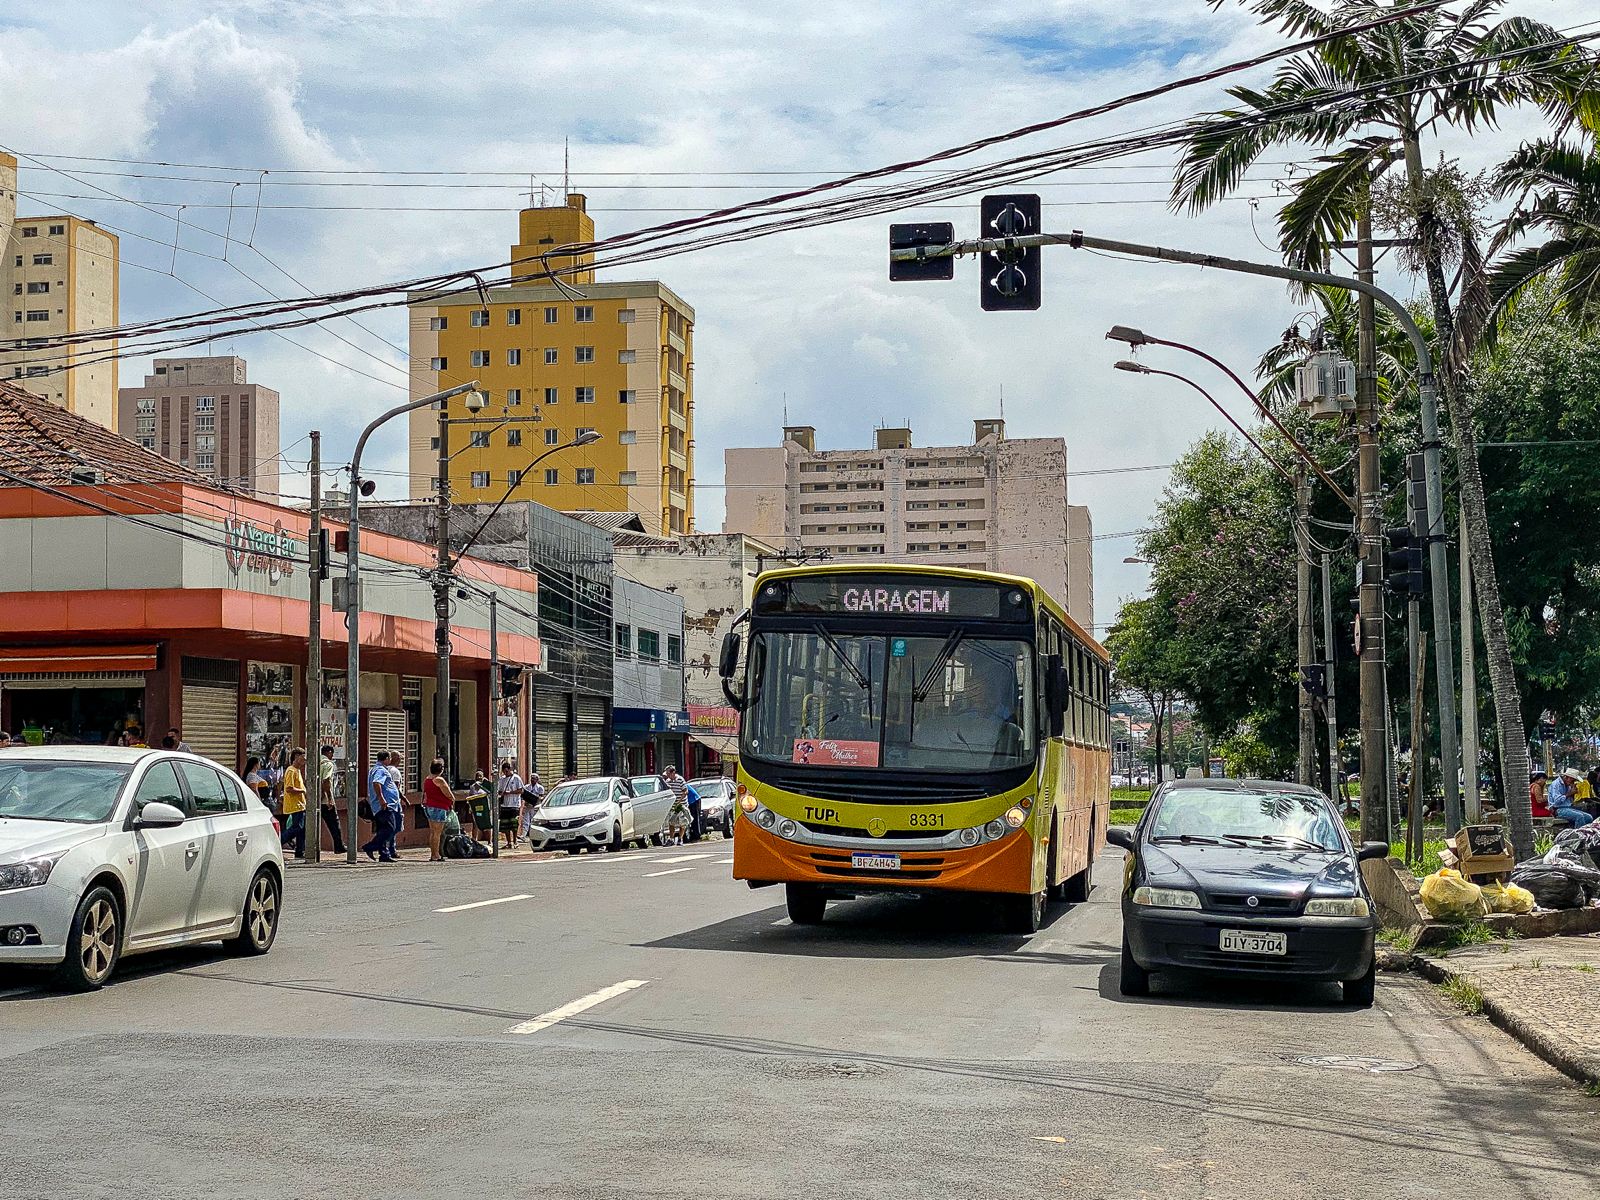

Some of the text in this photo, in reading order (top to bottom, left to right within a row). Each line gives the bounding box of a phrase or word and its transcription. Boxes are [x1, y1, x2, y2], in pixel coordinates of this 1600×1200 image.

[843, 588, 950, 613] GARAGEM
[909, 813, 944, 827] 8331
[857, 857, 896, 868] BFZ4H45
